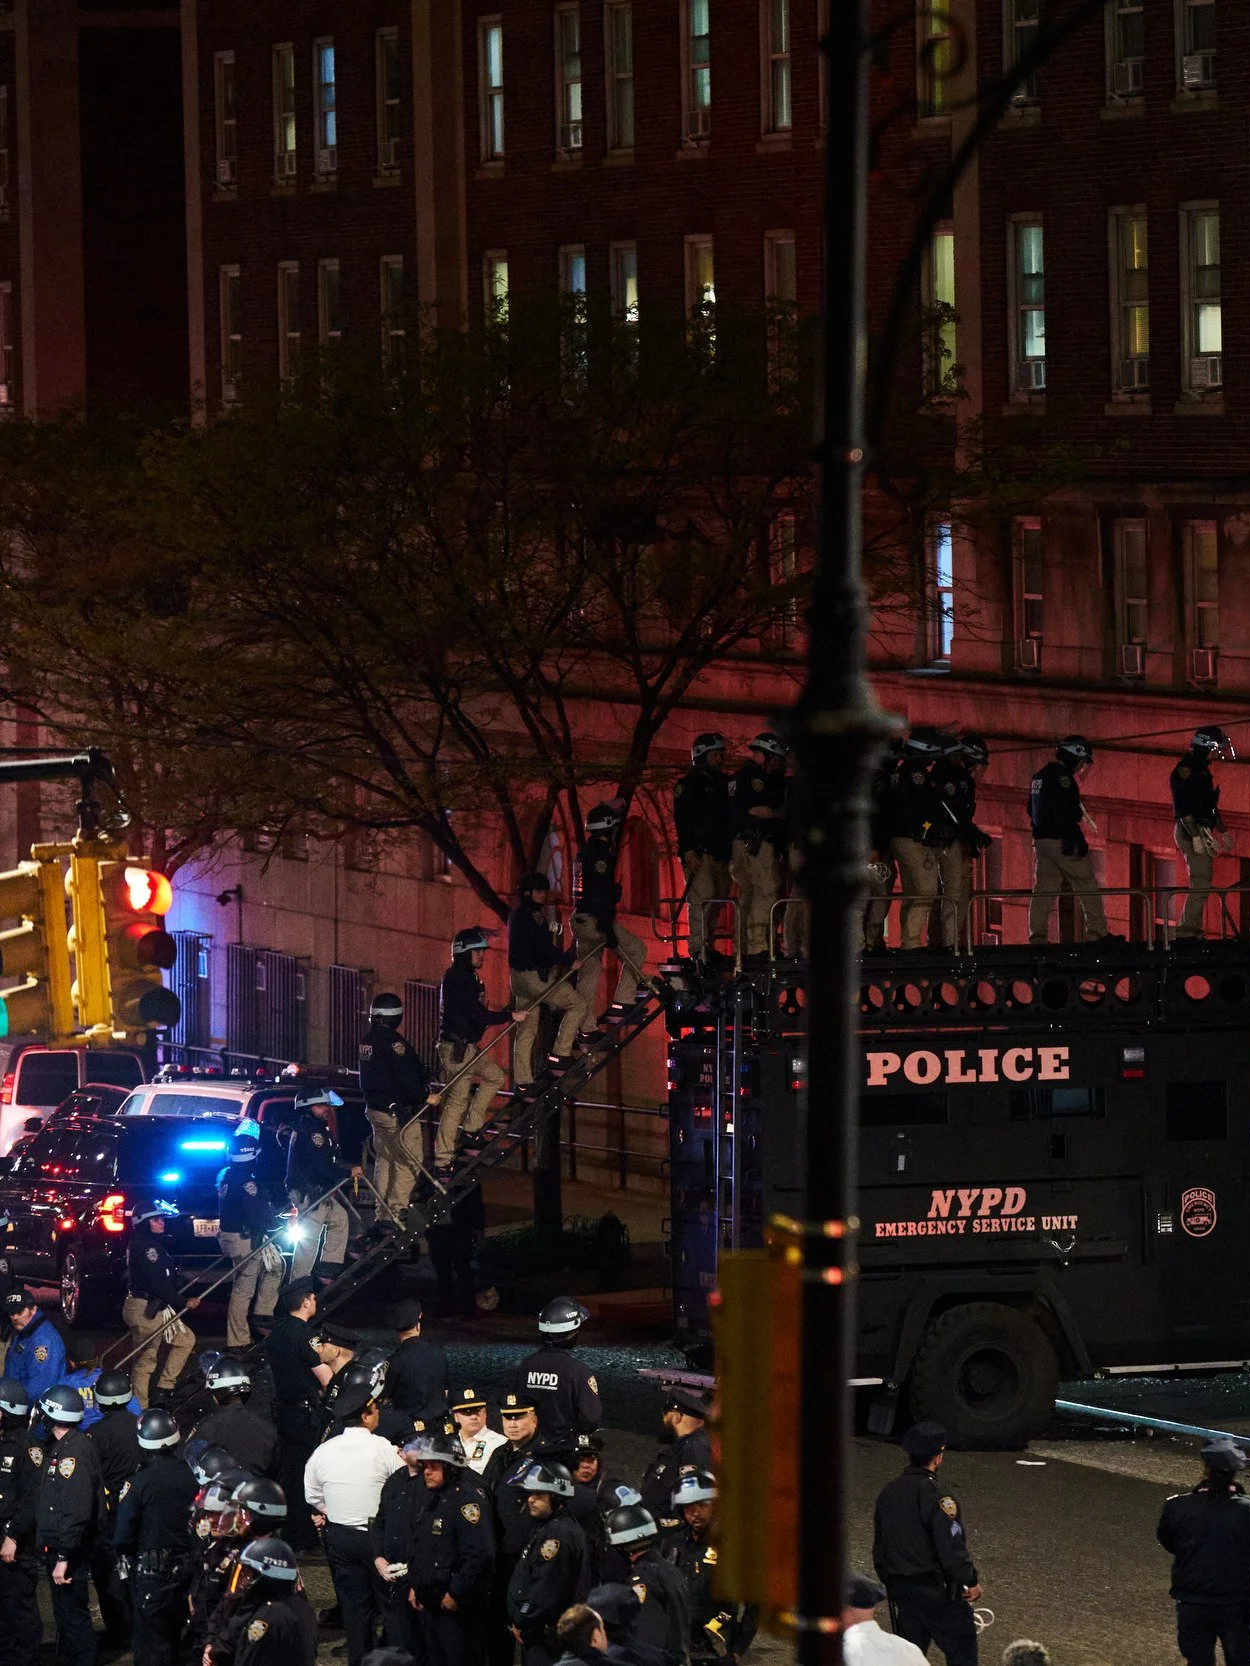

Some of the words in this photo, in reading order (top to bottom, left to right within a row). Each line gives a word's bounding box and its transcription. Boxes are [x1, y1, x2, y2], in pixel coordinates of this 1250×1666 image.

[866, 1046, 1070, 1086] POLICE
[927, 1187, 1026, 1218] NYPD
[1184, 1191, 1213, 1204] POLICE
[875, 1219, 967, 1237] EMERGENCY
[972, 1216, 1036, 1233] SERVICE
[1041, 1215, 1078, 1230] UNIT
[527, 1371, 559, 1386] NYPD
